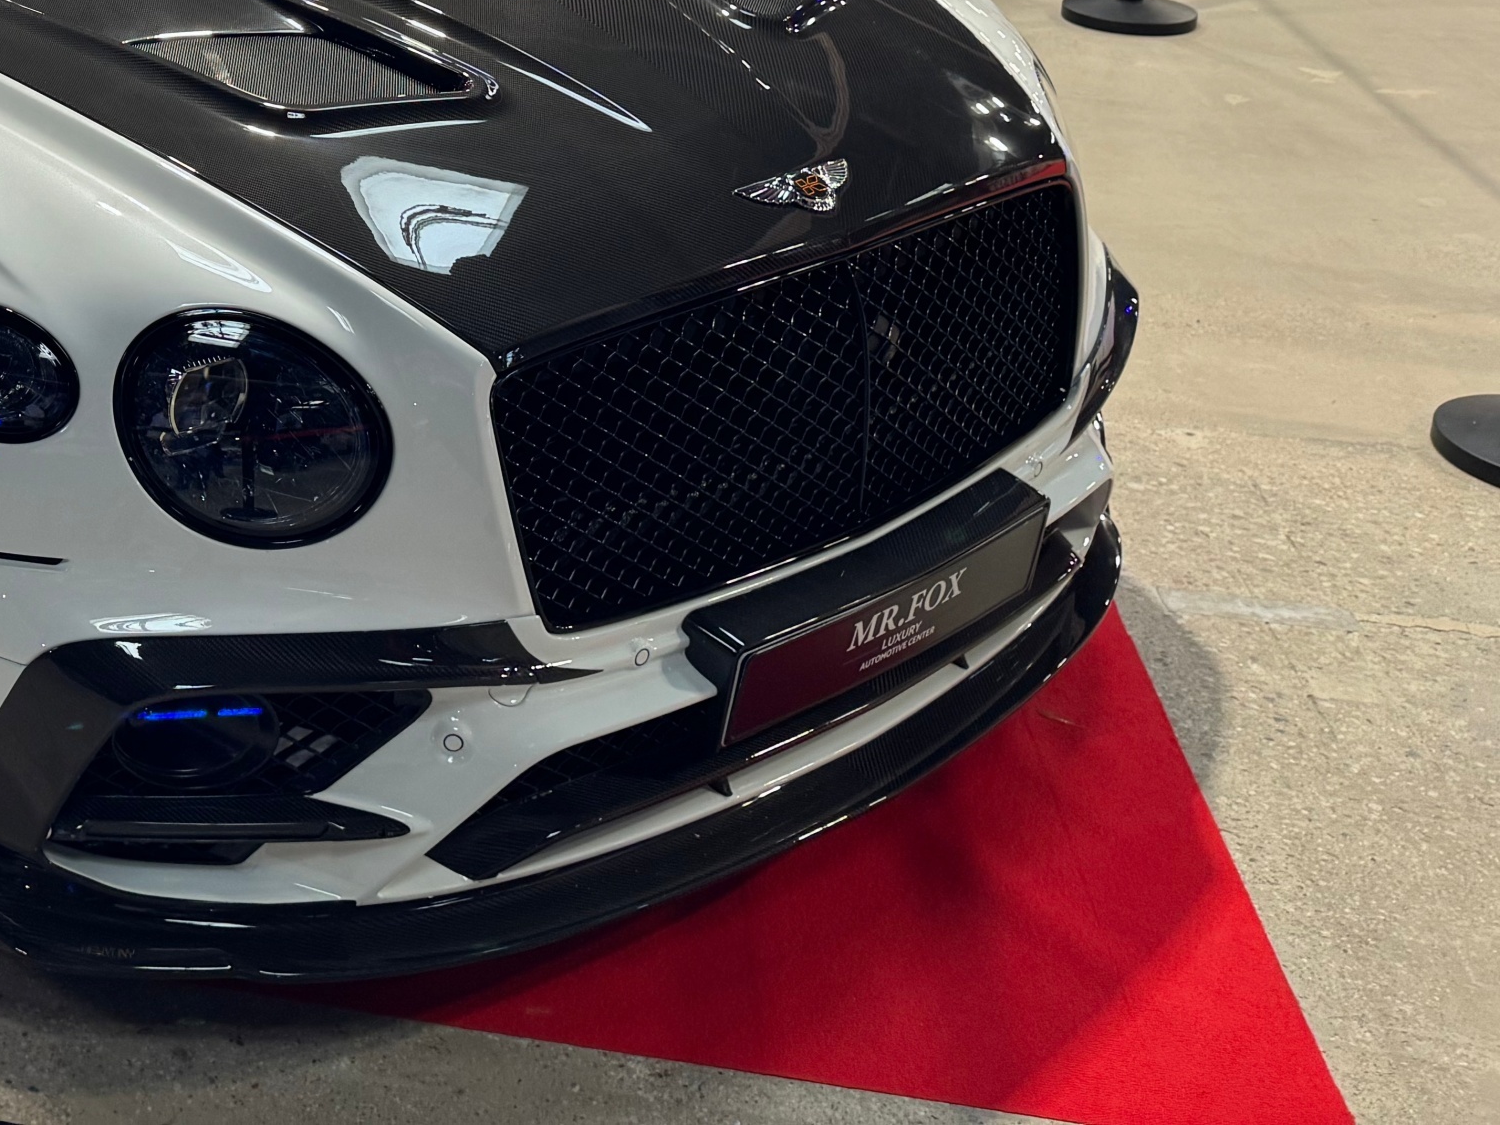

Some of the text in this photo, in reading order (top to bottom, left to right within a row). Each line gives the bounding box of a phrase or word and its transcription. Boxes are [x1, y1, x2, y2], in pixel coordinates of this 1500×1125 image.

[846, 567, 968, 652] MR.FOX
[859, 625, 936, 672] AUTOMOTIVE CENTER
[881, 620, 923, 651] LUXURY
